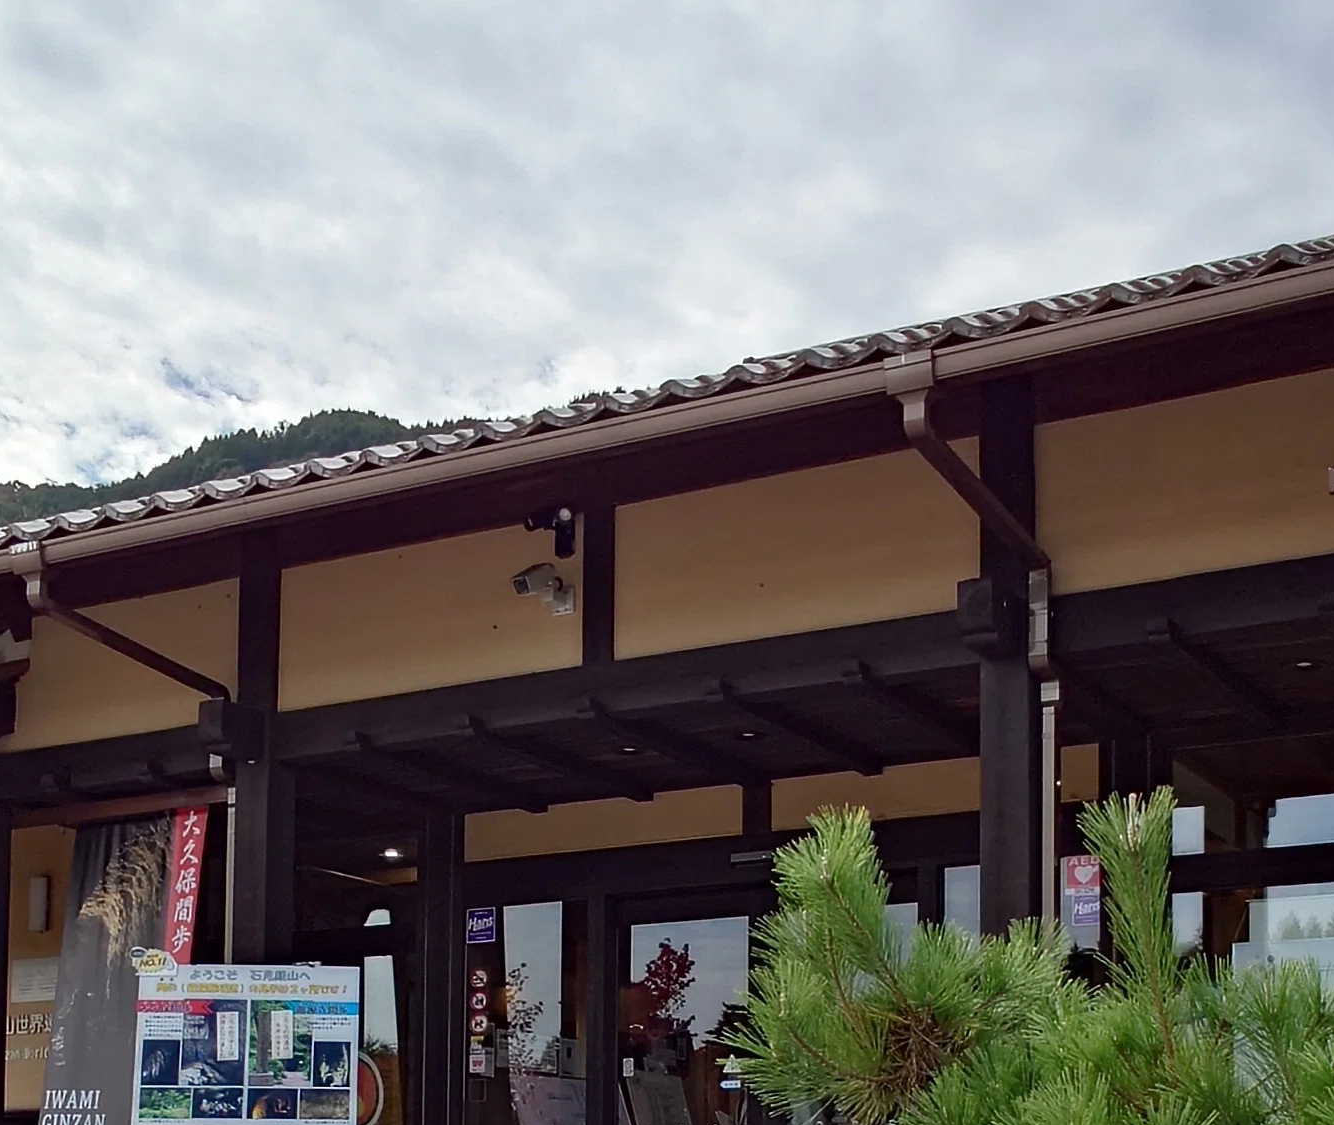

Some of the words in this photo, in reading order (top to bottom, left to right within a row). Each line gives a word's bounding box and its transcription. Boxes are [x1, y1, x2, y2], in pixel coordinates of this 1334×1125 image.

[1068, 856, 1099, 866] AED
[171, 810, 200, 954] 大久保間歩
[189, 969, 238, 980] ようこそ
[44, 1090, 101, 1109] IWAMI
